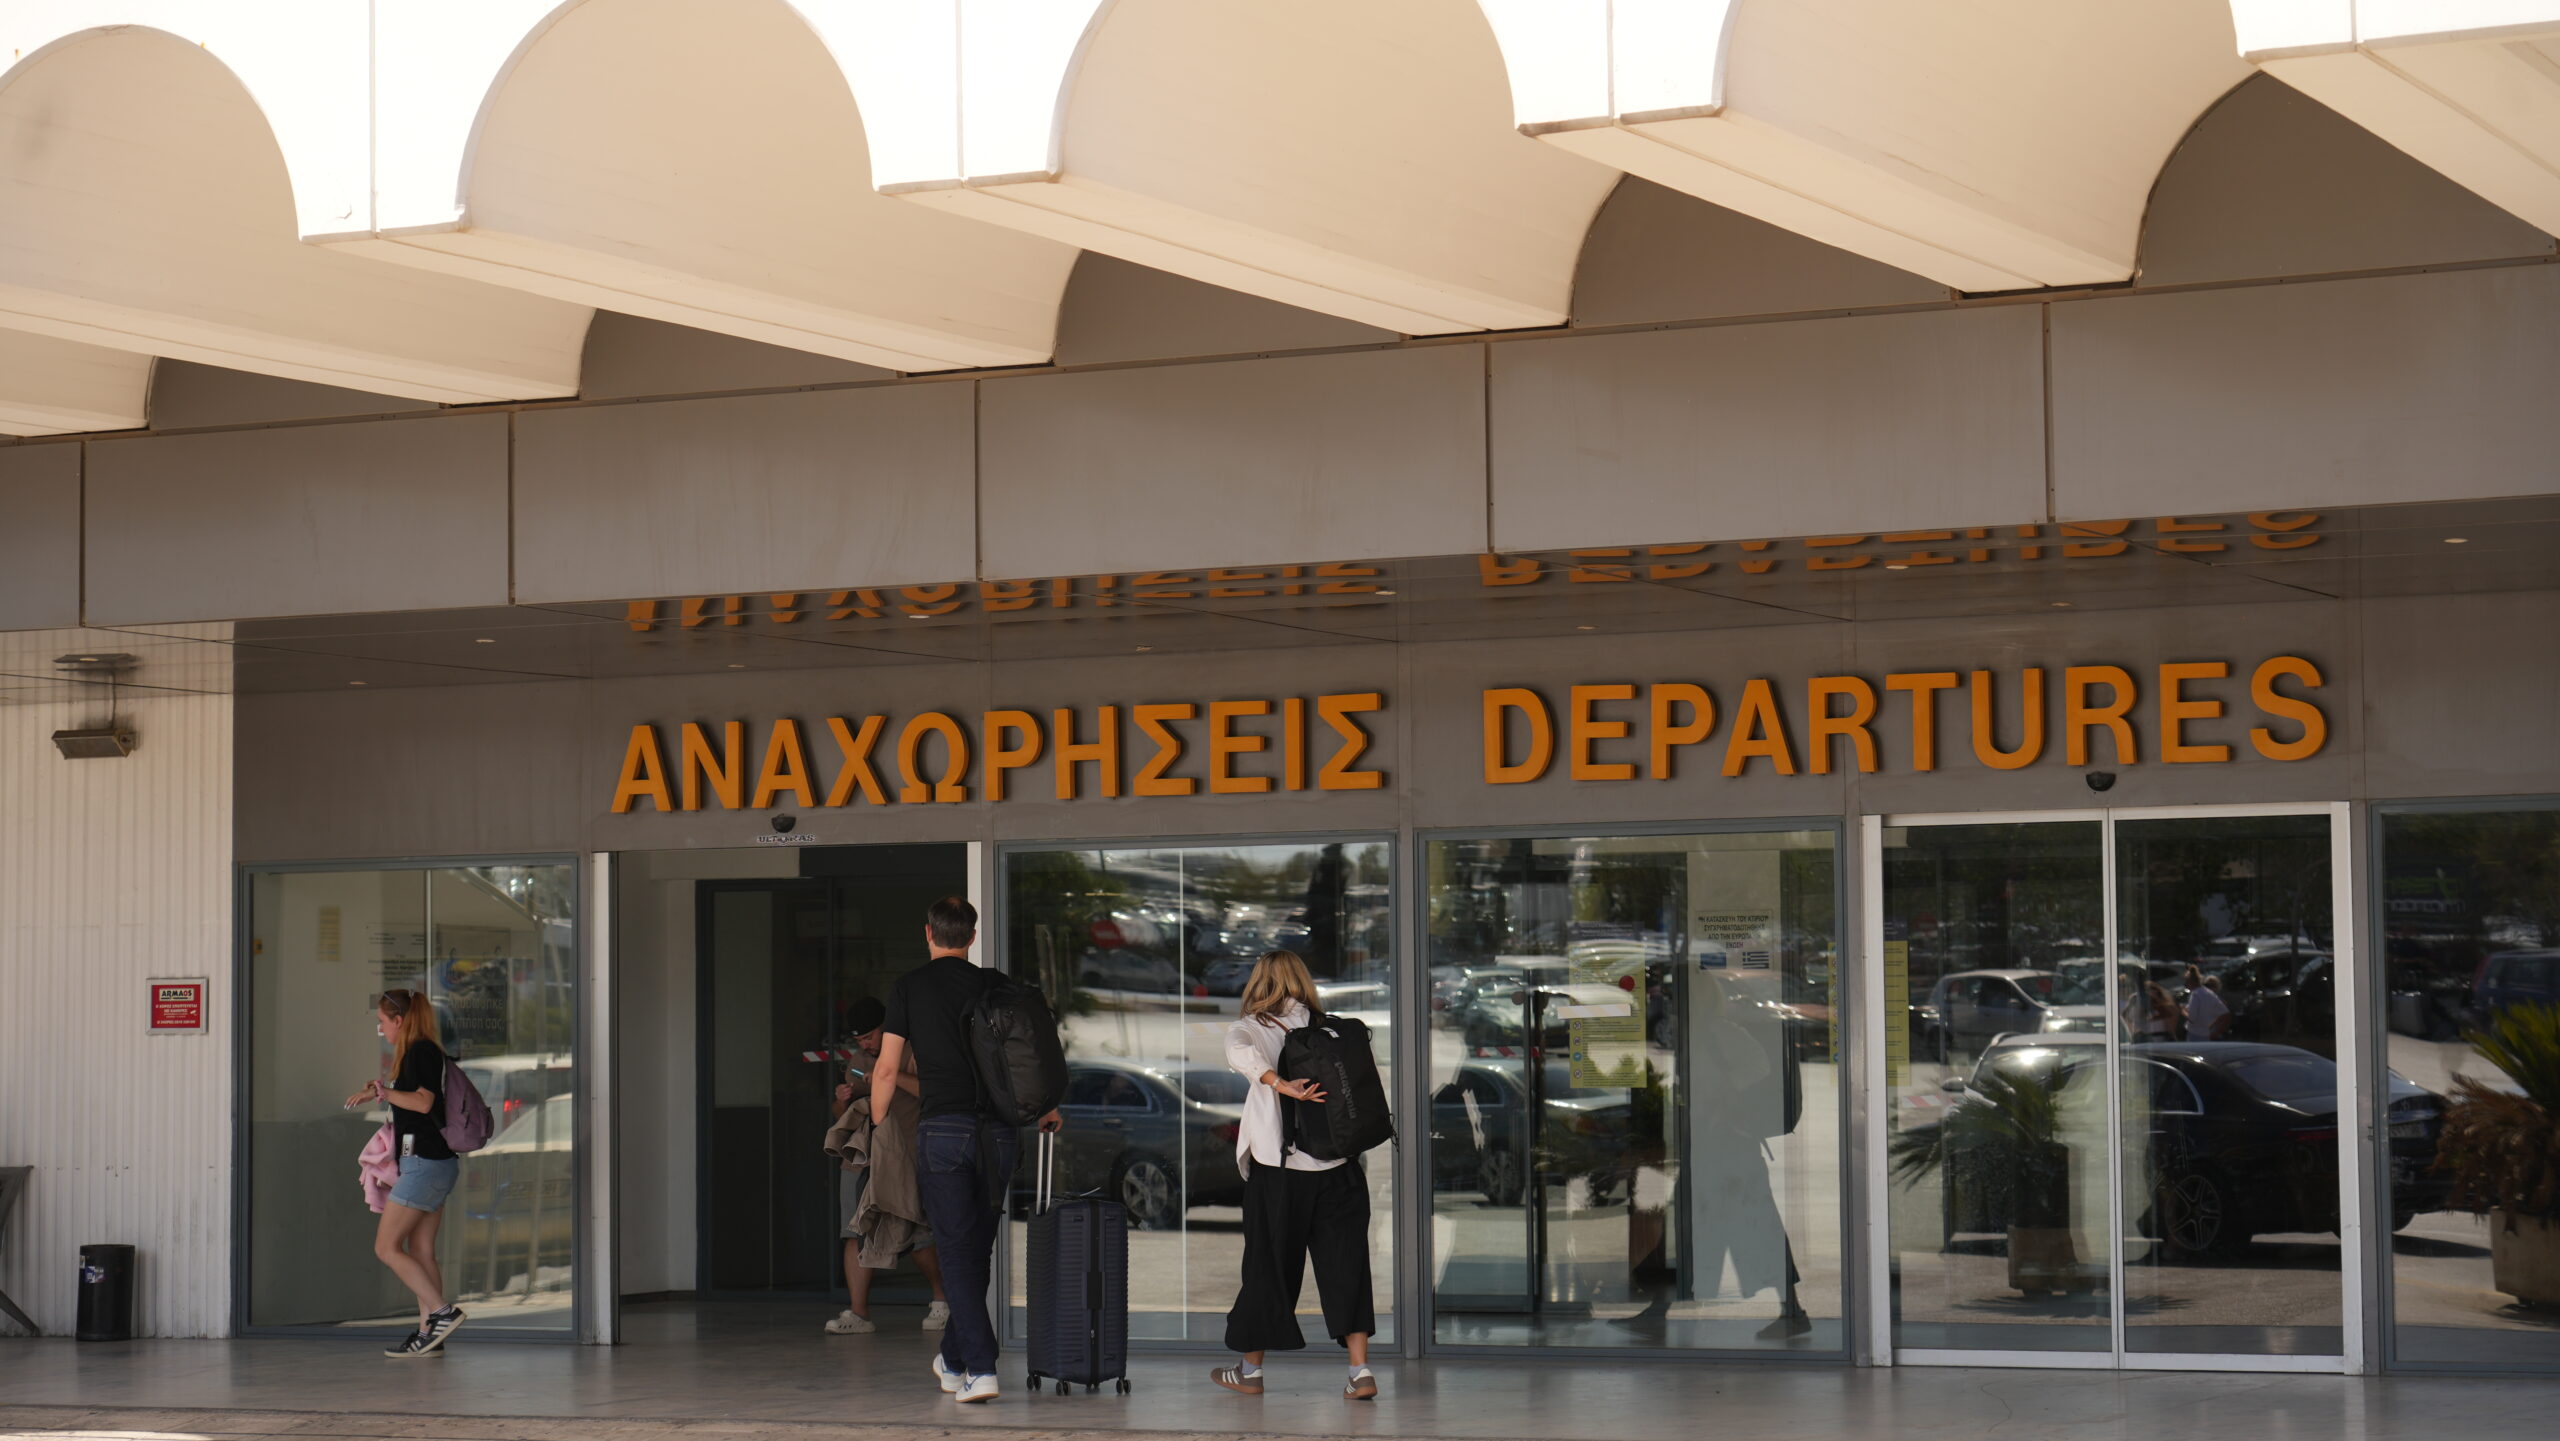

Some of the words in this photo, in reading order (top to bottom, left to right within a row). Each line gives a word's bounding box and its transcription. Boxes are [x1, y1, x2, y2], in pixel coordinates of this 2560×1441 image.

[611, 692, 1383, 813] ΑΝΑΧΩΡΗΣΕΙΣ
[1482, 656, 2328, 785] DEPARTURES
[1334, 1061, 1357, 1119] patagonia
